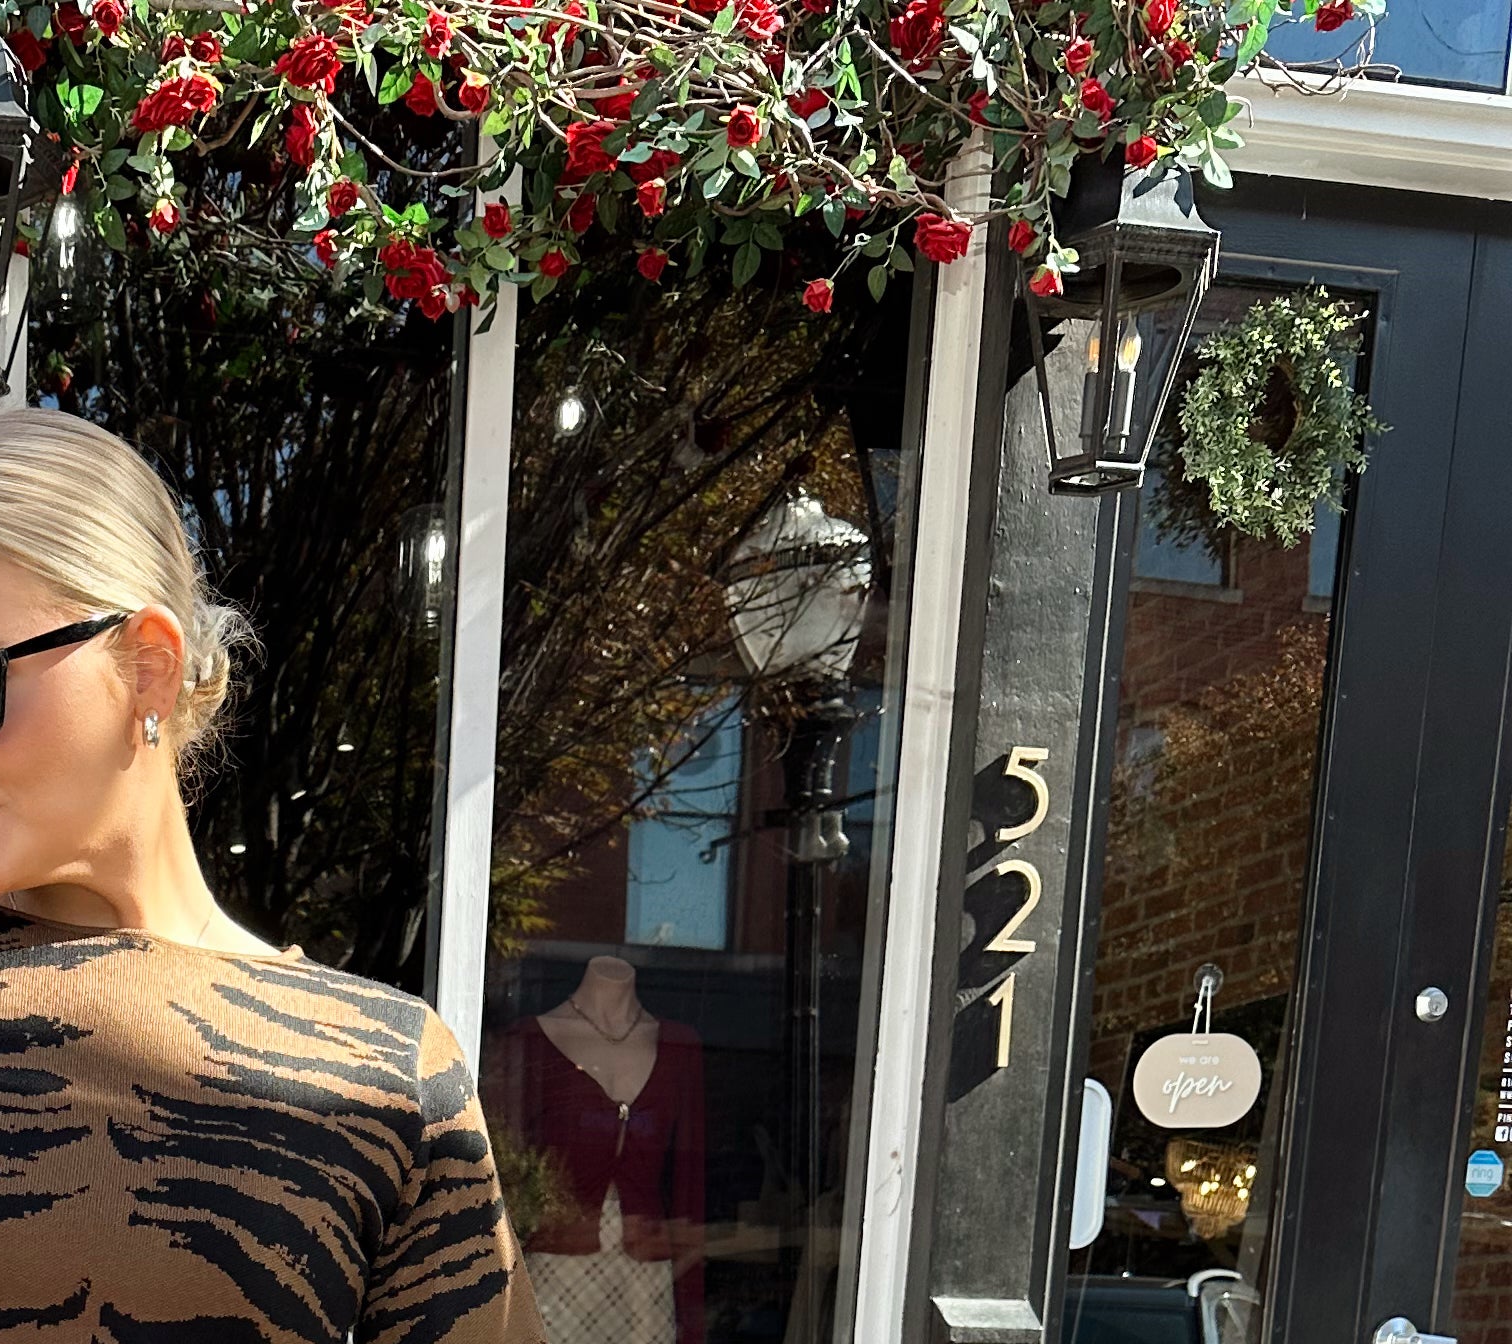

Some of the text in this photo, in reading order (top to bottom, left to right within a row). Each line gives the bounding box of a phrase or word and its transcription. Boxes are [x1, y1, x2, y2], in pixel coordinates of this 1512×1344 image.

[983, 746, 1049, 1067] 521
[1179, 1055, 1220, 1065] we are
[1162, 1071, 1233, 1114] open
[1471, 1168, 1494, 1182] ring
